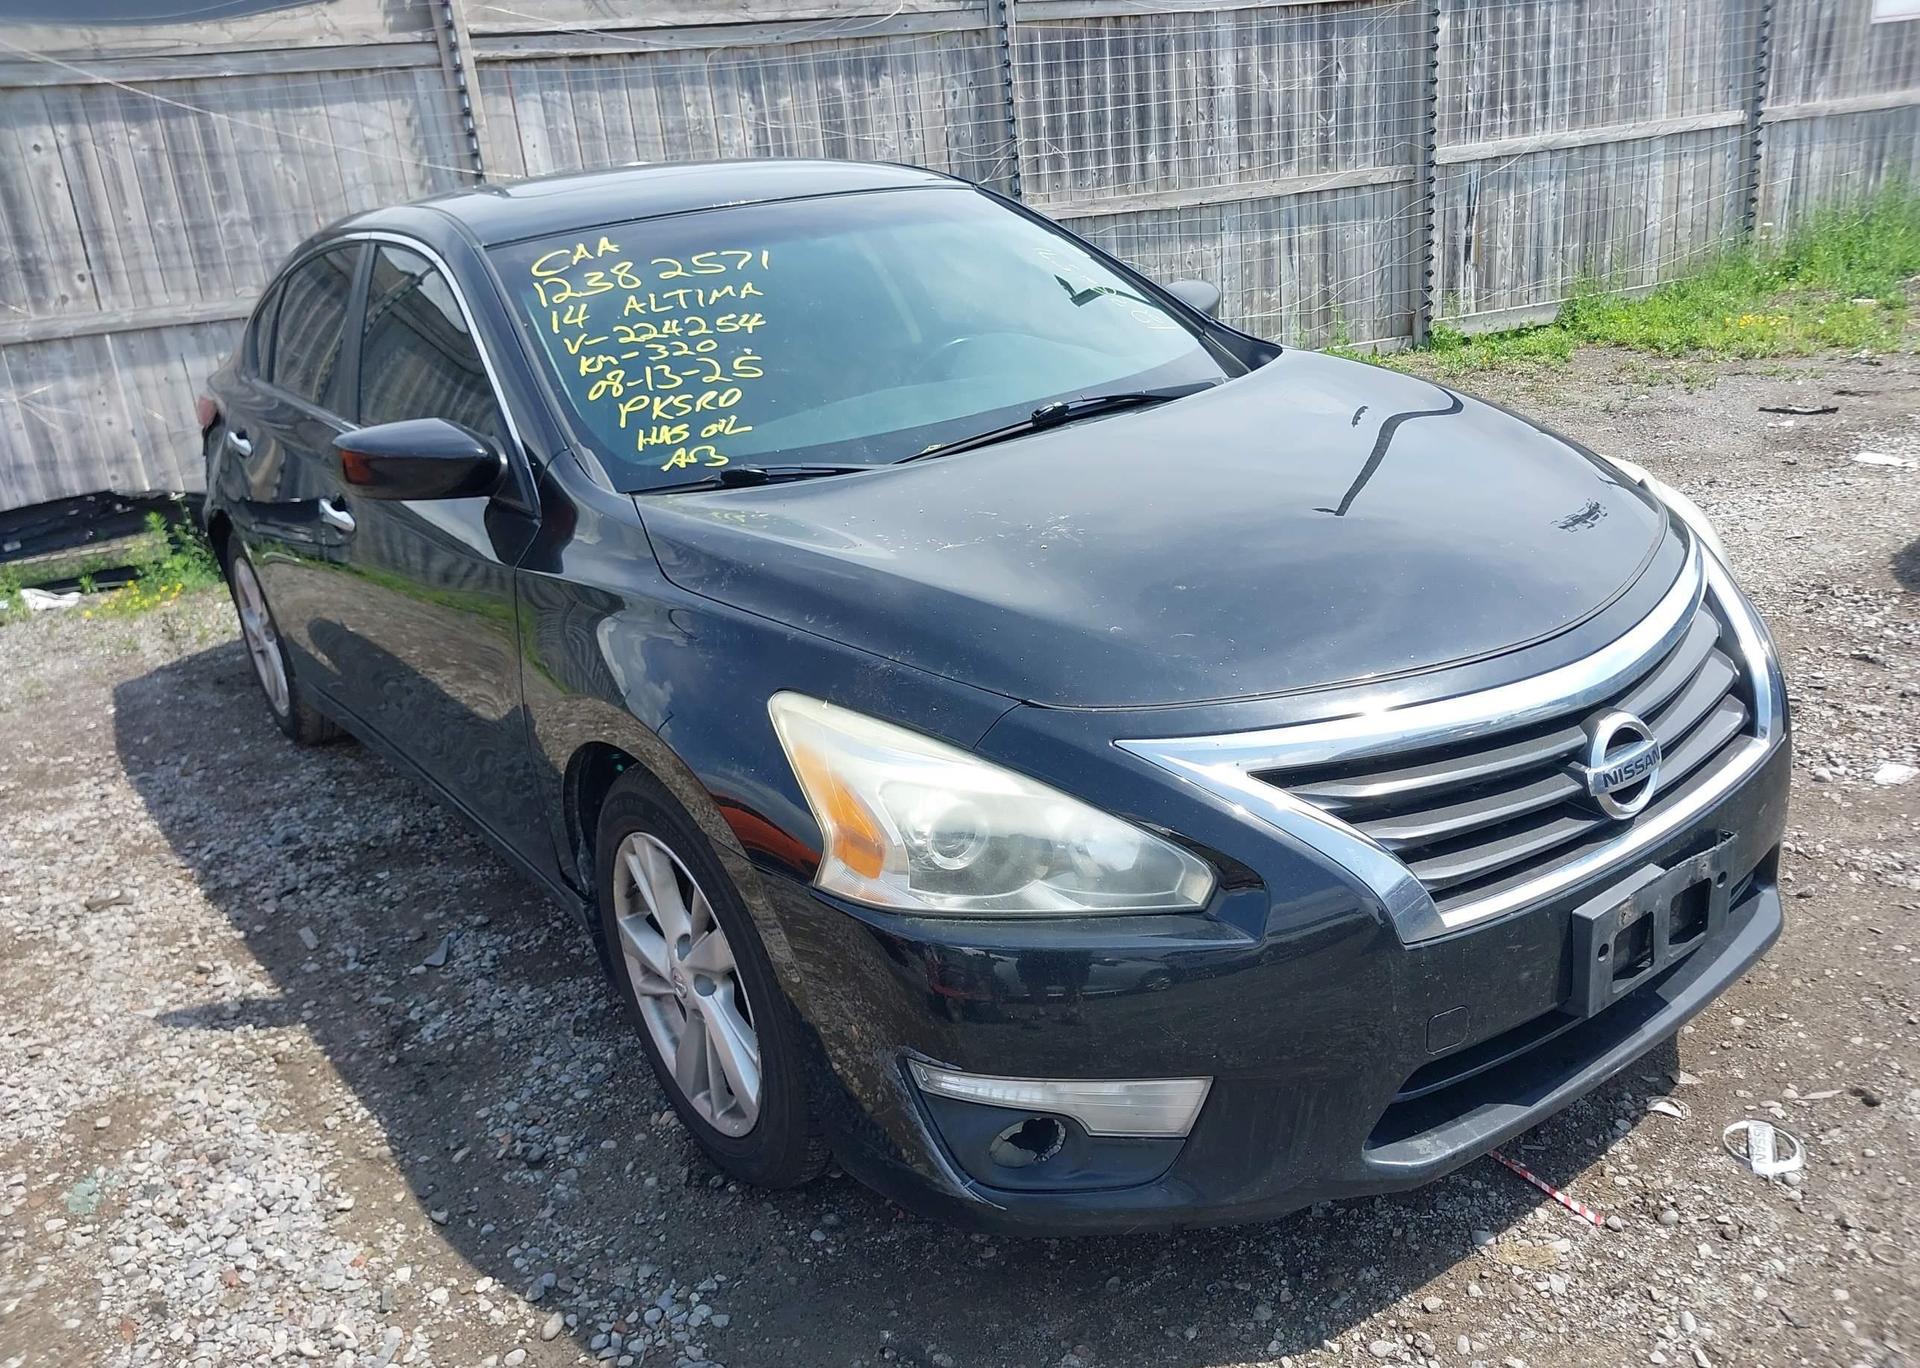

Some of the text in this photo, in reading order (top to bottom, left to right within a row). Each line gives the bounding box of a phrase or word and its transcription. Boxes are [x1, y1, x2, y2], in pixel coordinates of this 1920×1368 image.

[531, 236, 619, 277] CAA
[551, 282, 764, 334] 14 ALTIMA
[1603, 746, 1660, 787] NISSAN
